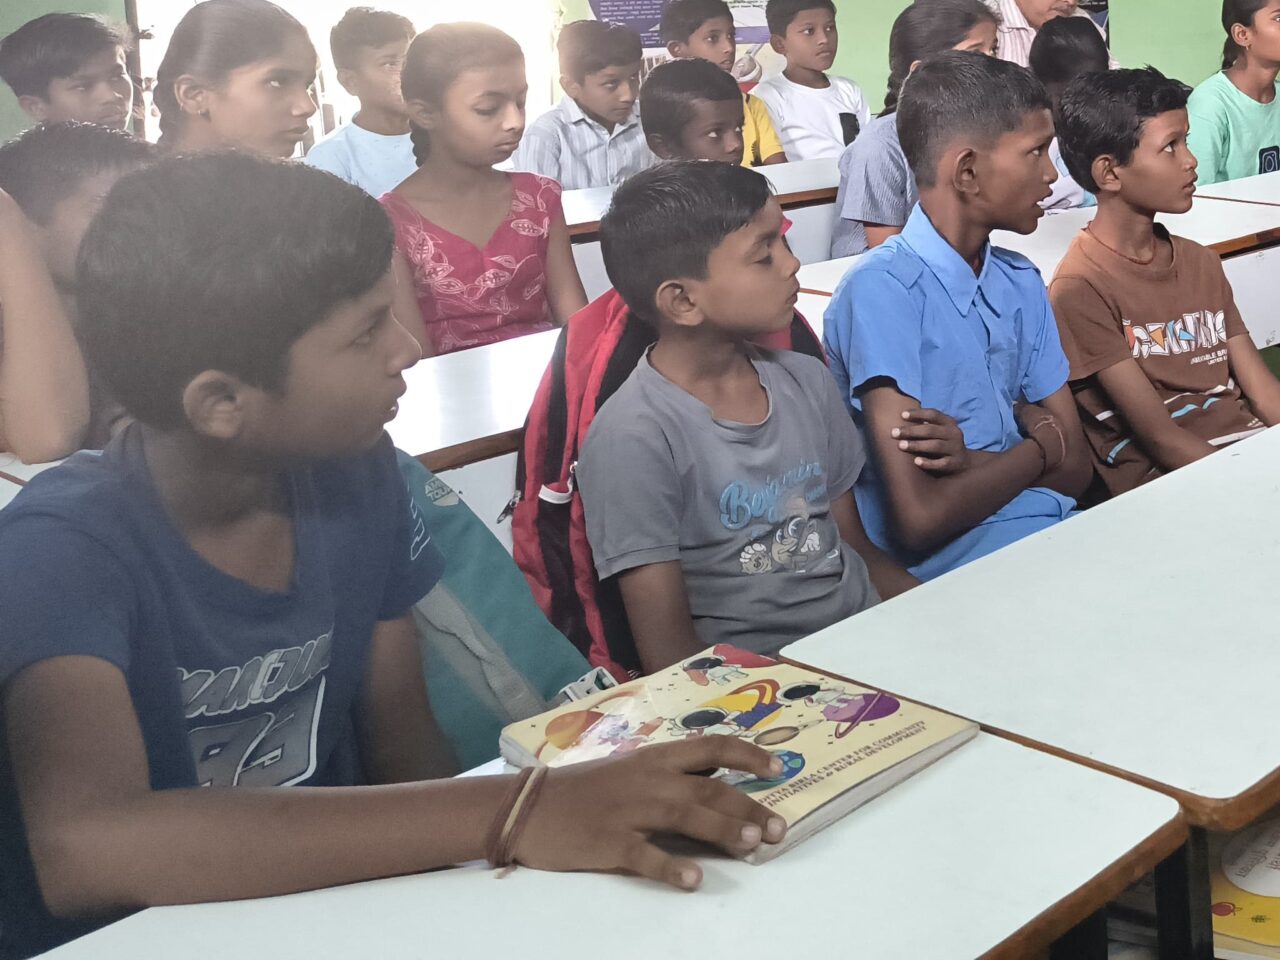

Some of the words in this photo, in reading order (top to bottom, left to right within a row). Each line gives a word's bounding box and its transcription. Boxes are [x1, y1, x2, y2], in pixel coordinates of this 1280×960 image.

[817, 751, 856, 778] CENTER
[852, 743, 874, 757] FOR
[872, 720, 926, 748] COMMUNITY
[835, 754, 866, 773] RURAL
[863, 726, 928, 757] DEVELOPMENT
